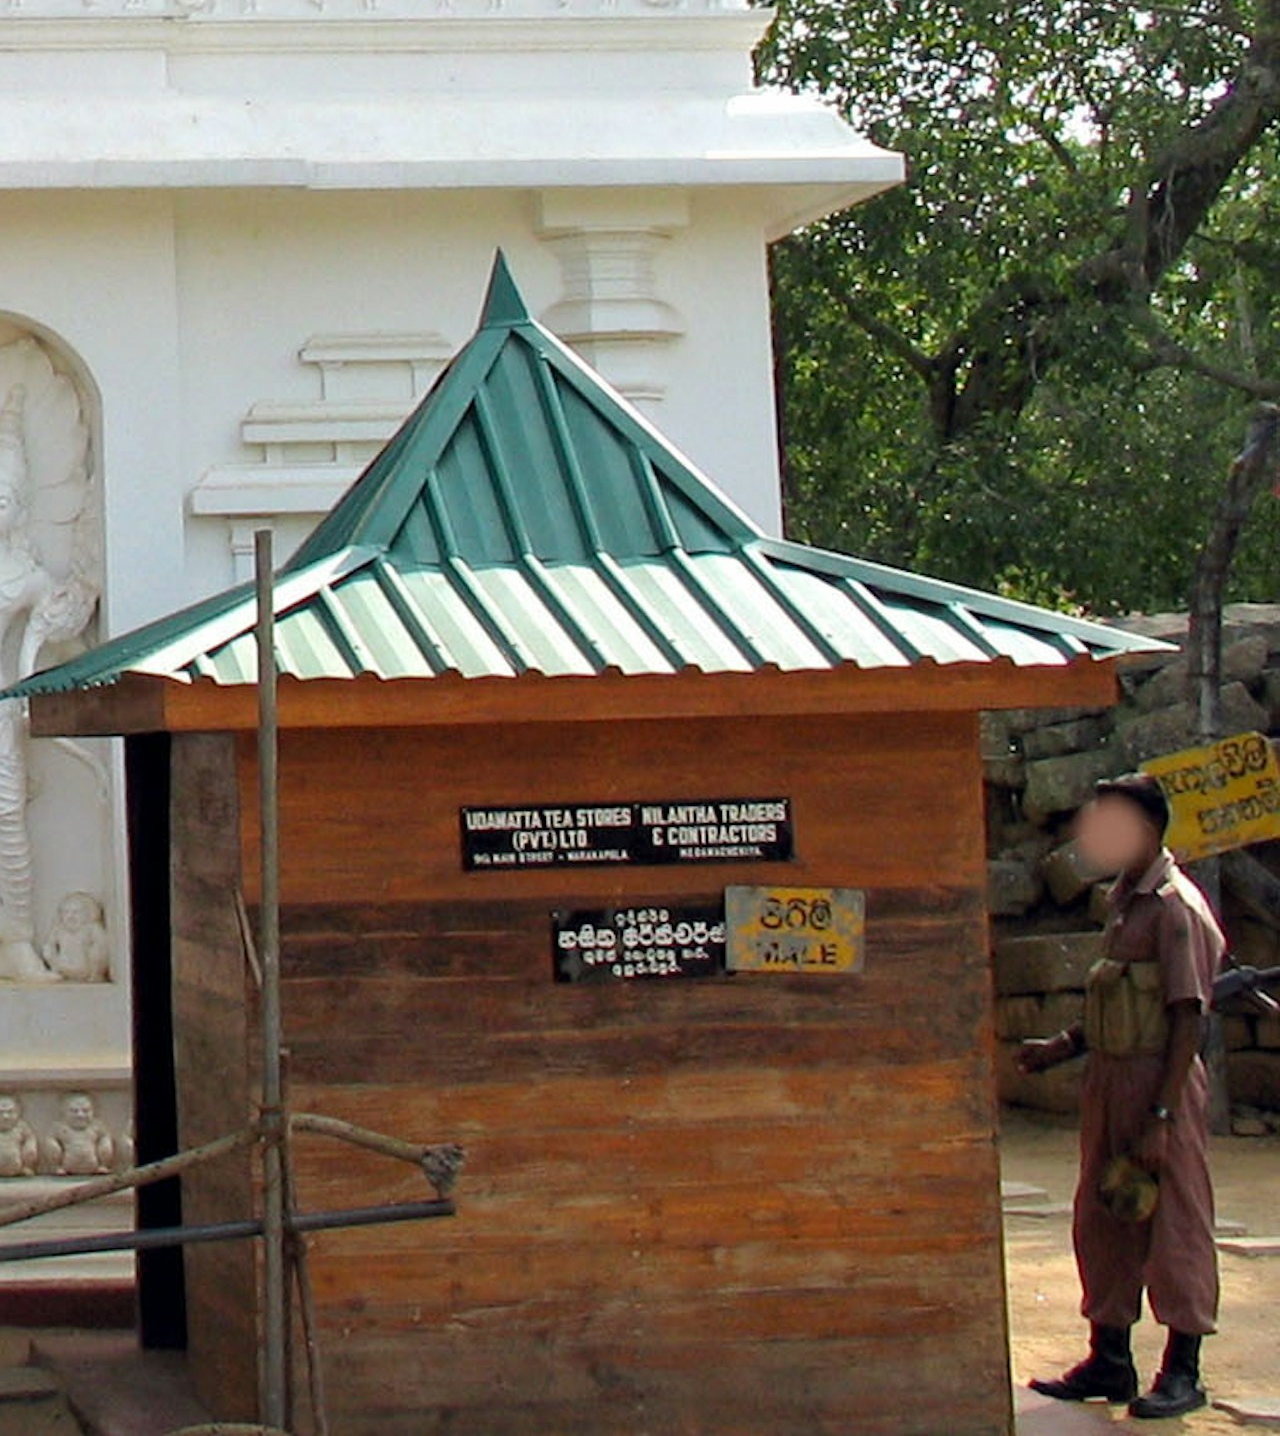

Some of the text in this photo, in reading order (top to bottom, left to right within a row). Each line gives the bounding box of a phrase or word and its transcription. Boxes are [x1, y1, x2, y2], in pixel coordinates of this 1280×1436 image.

[543, 809, 573, 828] TEA
[576, 807, 632, 827] STORES
[642, 802, 786, 826] NILANTHA TRADERS
[667, 823, 777, 845] CONTRACTORS
